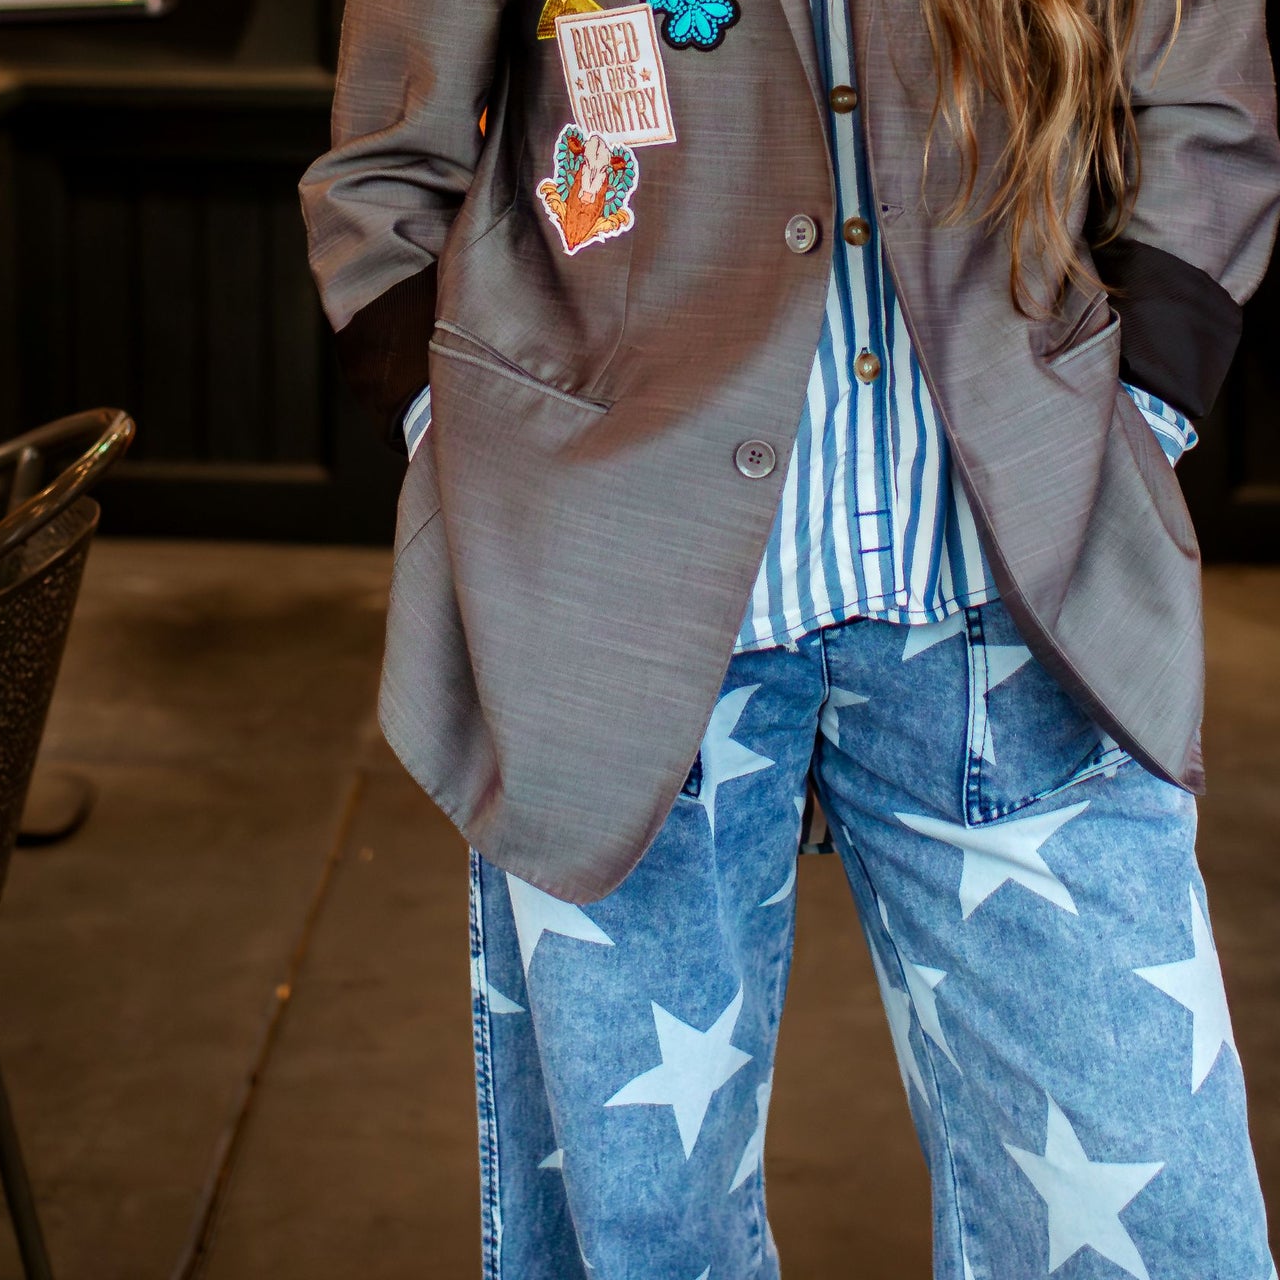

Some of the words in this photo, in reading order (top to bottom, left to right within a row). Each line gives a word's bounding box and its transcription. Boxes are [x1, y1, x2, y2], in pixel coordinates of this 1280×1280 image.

[570, 21, 640, 70] RAISED
[586, 68, 605, 94] ON
[580, 86, 660, 134] COUNTRY
